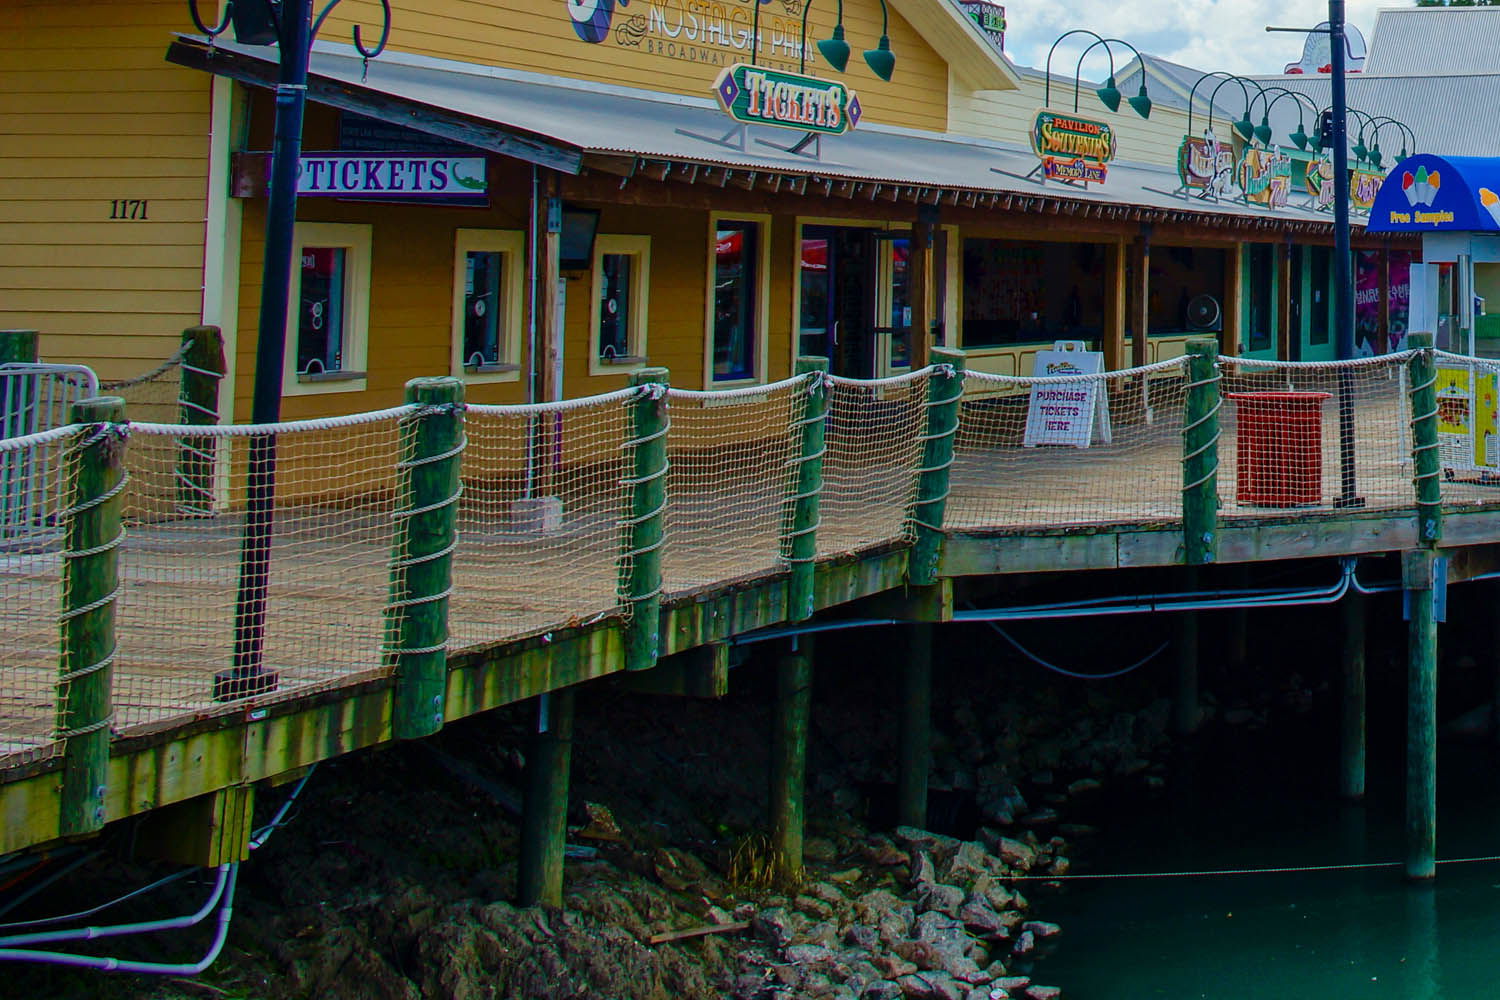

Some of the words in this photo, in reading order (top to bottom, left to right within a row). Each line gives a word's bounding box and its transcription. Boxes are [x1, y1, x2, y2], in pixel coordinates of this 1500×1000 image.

[771, 17, 816, 63] PARK
[648, 40, 727, 66] BROADWAY
[745, 70, 841, 128] TICKETS
[1053, 117, 1101, 134] PAVILION
[1041, 122, 1110, 163] SOUVENIRS
[304, 159, 449, 191] TICKETS
[1055, 164, 1084, 178] MEMORY
[1085, 167, 1102, 180] LANE
[109, 199, 149, 220] 1171
[1390, 211, 1410, 223] Free
[1414, 210, 1454, 226] Samples
[1037, 391, 1087, 402] PURCHASE
[1040, 406, 1080, 417] TICKETS
[1045, 421, 1070, 431] HERE
